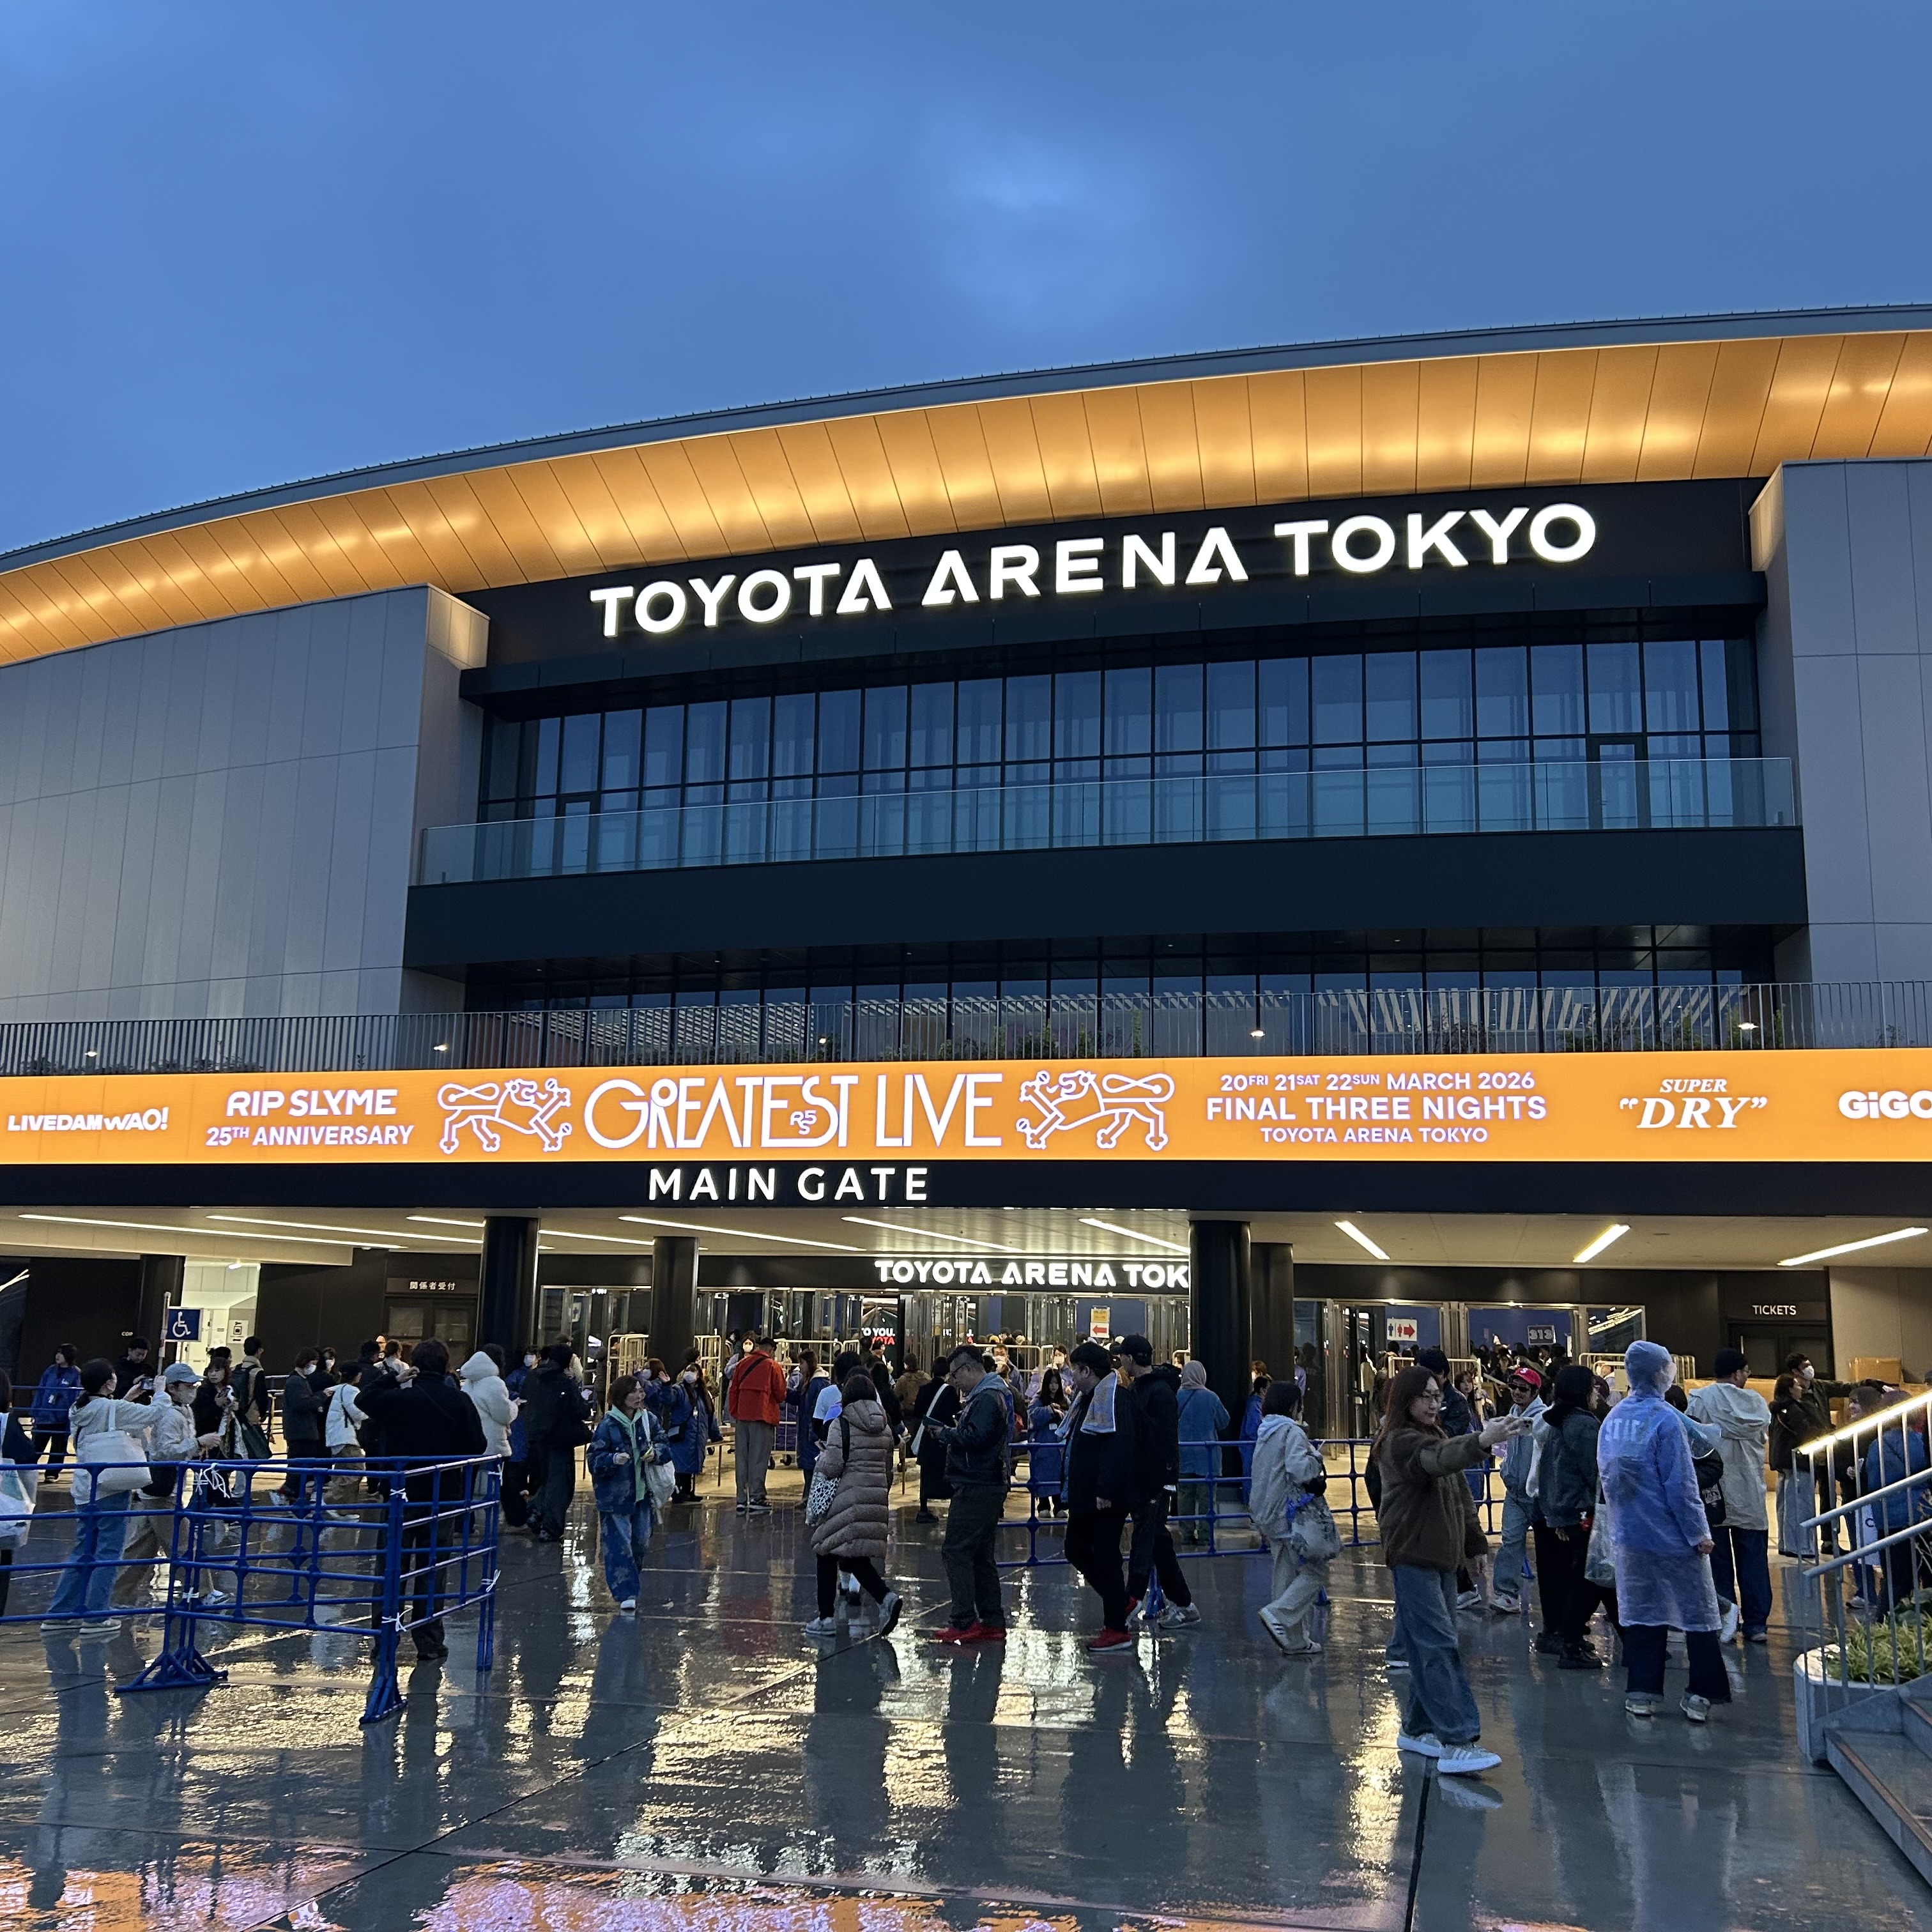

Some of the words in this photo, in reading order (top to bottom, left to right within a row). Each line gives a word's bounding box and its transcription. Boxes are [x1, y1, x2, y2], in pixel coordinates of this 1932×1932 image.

[590, 558, 893, 638] TOYOTA
[921, 527, 1249, 606] ARENA
[1274, 503, 1596, 577] TOKYO
[1387, 1073, 1470, 1091] MARCH
[1478, 1072, 1535, 1089] 2026
[1660, 1078, 1727, 1093] SUPER
[226, 1090, 285, 1117] RIP
[288, 1089, 398, 1117] SLYME
[584, 1075, 859, 1149] GREATEST
[876, 1073, 1003, 1147] LIVE
[1207, 1096, 1296, 1121] FINAL
[1306, 1096, 1411, 1121] THREE
[1423, 1095, 1547, 1120] NIGHTS
[252, 1124, 414, 1146] ANNIVERSARY
[1261, 1127, 1337, 1143] TOYOTA
[1343, 1127, 1413, 1143] ARENA
[1418, 1126, 1488, 1143] TOKYO
[648, 1168, 776, 1201] MAIN
[797, 1167, 928, 1201] GATE
[409, 1281, 456, 1291] 関係者受付
[875, 1261, 992, 1284] TOYOTA
[1001, 1261, 1117, 1287] ARENA
[1123, 1264, 1190, 1289] TOK
[1752, 1305, 1797, 1315] TICKETS
[872, 1327, 896, 1337] YOU.
